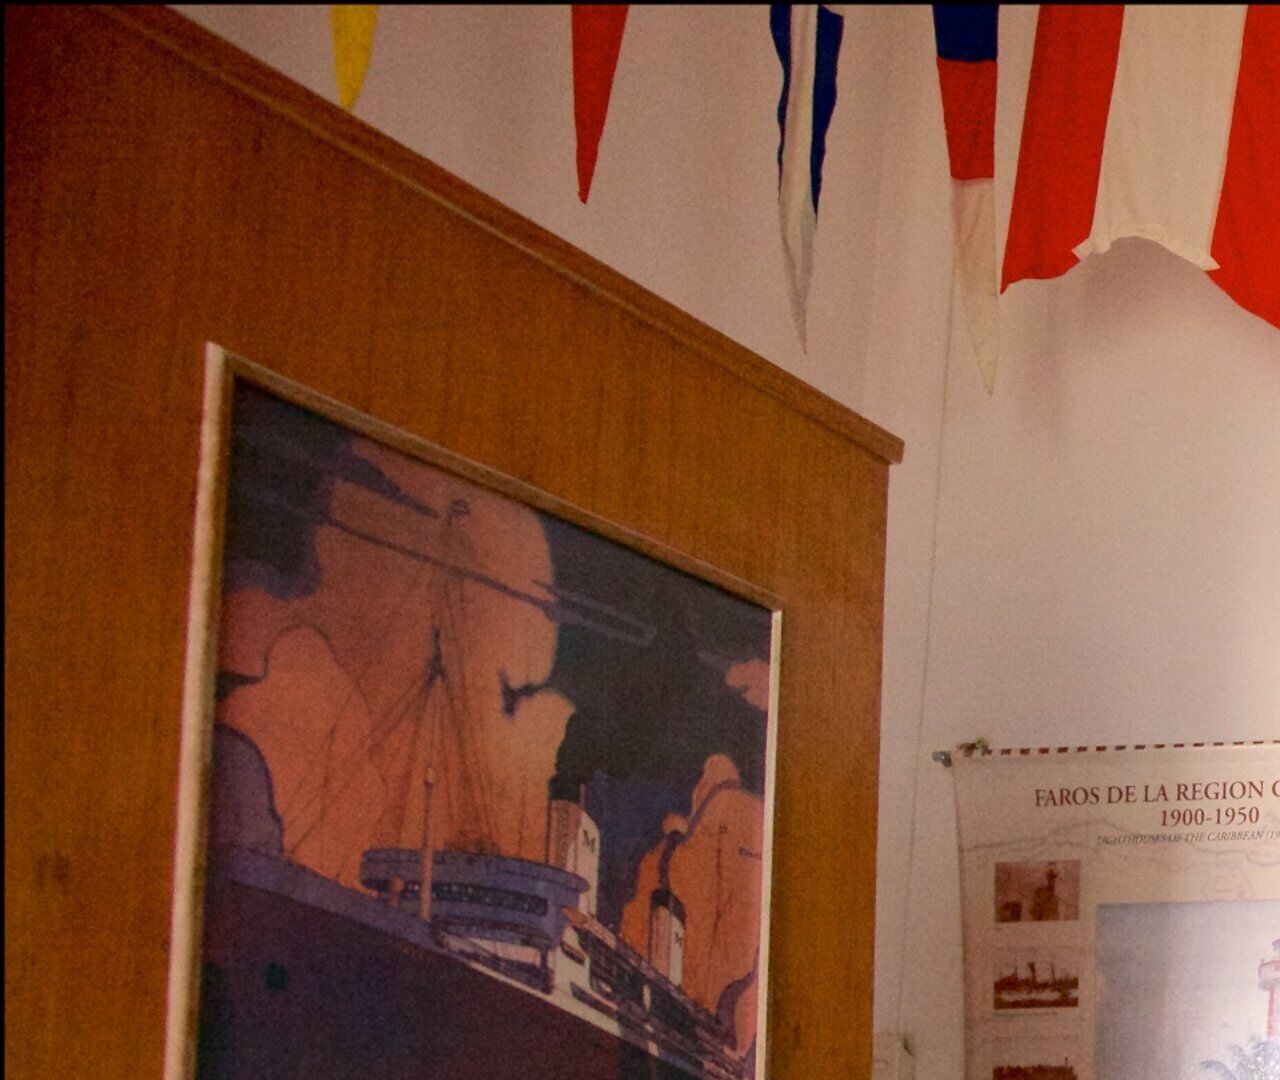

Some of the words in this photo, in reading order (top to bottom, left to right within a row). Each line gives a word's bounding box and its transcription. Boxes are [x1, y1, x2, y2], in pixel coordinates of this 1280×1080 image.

[1034, 787, 1101, 808] FAROS
[1107, 785, 1136, 804] DE
[1143, 784, 1169, 802] LA
[1176, 780, 1265, 802] REGION
[1160, 806, 1260, 828] 1900-1950
